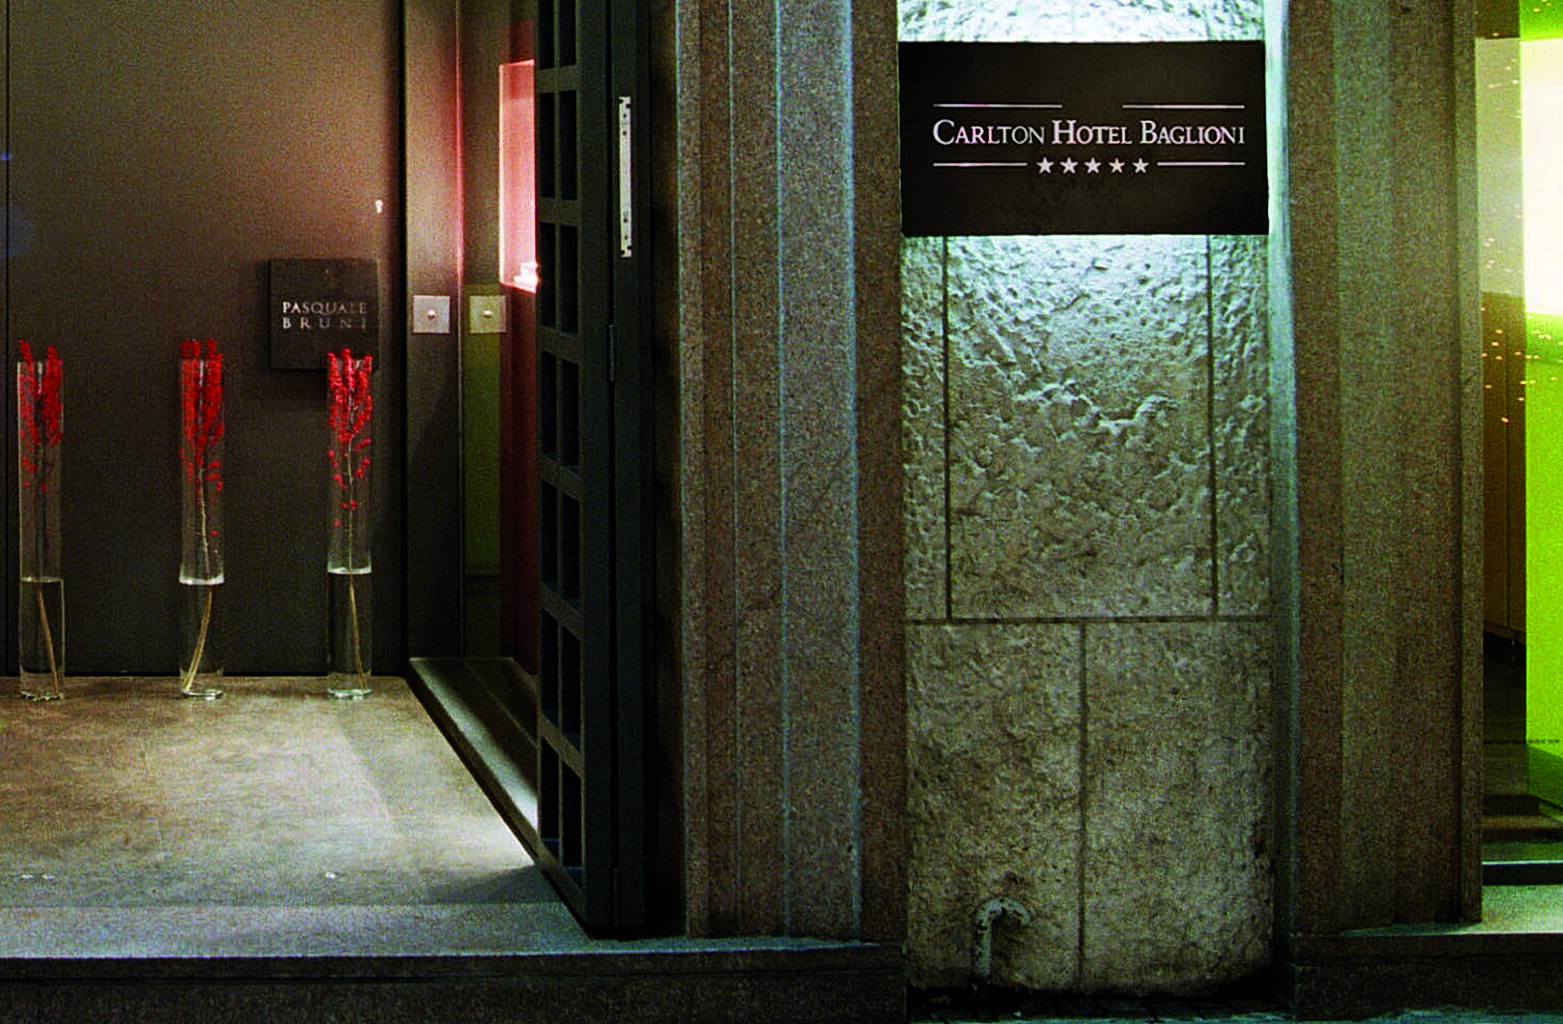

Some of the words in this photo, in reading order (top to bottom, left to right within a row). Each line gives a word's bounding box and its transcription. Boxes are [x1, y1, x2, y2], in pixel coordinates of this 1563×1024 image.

[933, 119, 1045, 145] CARLTON
[1052, 119, 1132, 145] HOTEL
[1140, 120, 1245, 145] BAGLIONI
[282, 301, 368, 315] PASQUALE
[282, 317, 366, 329] BRUNI
